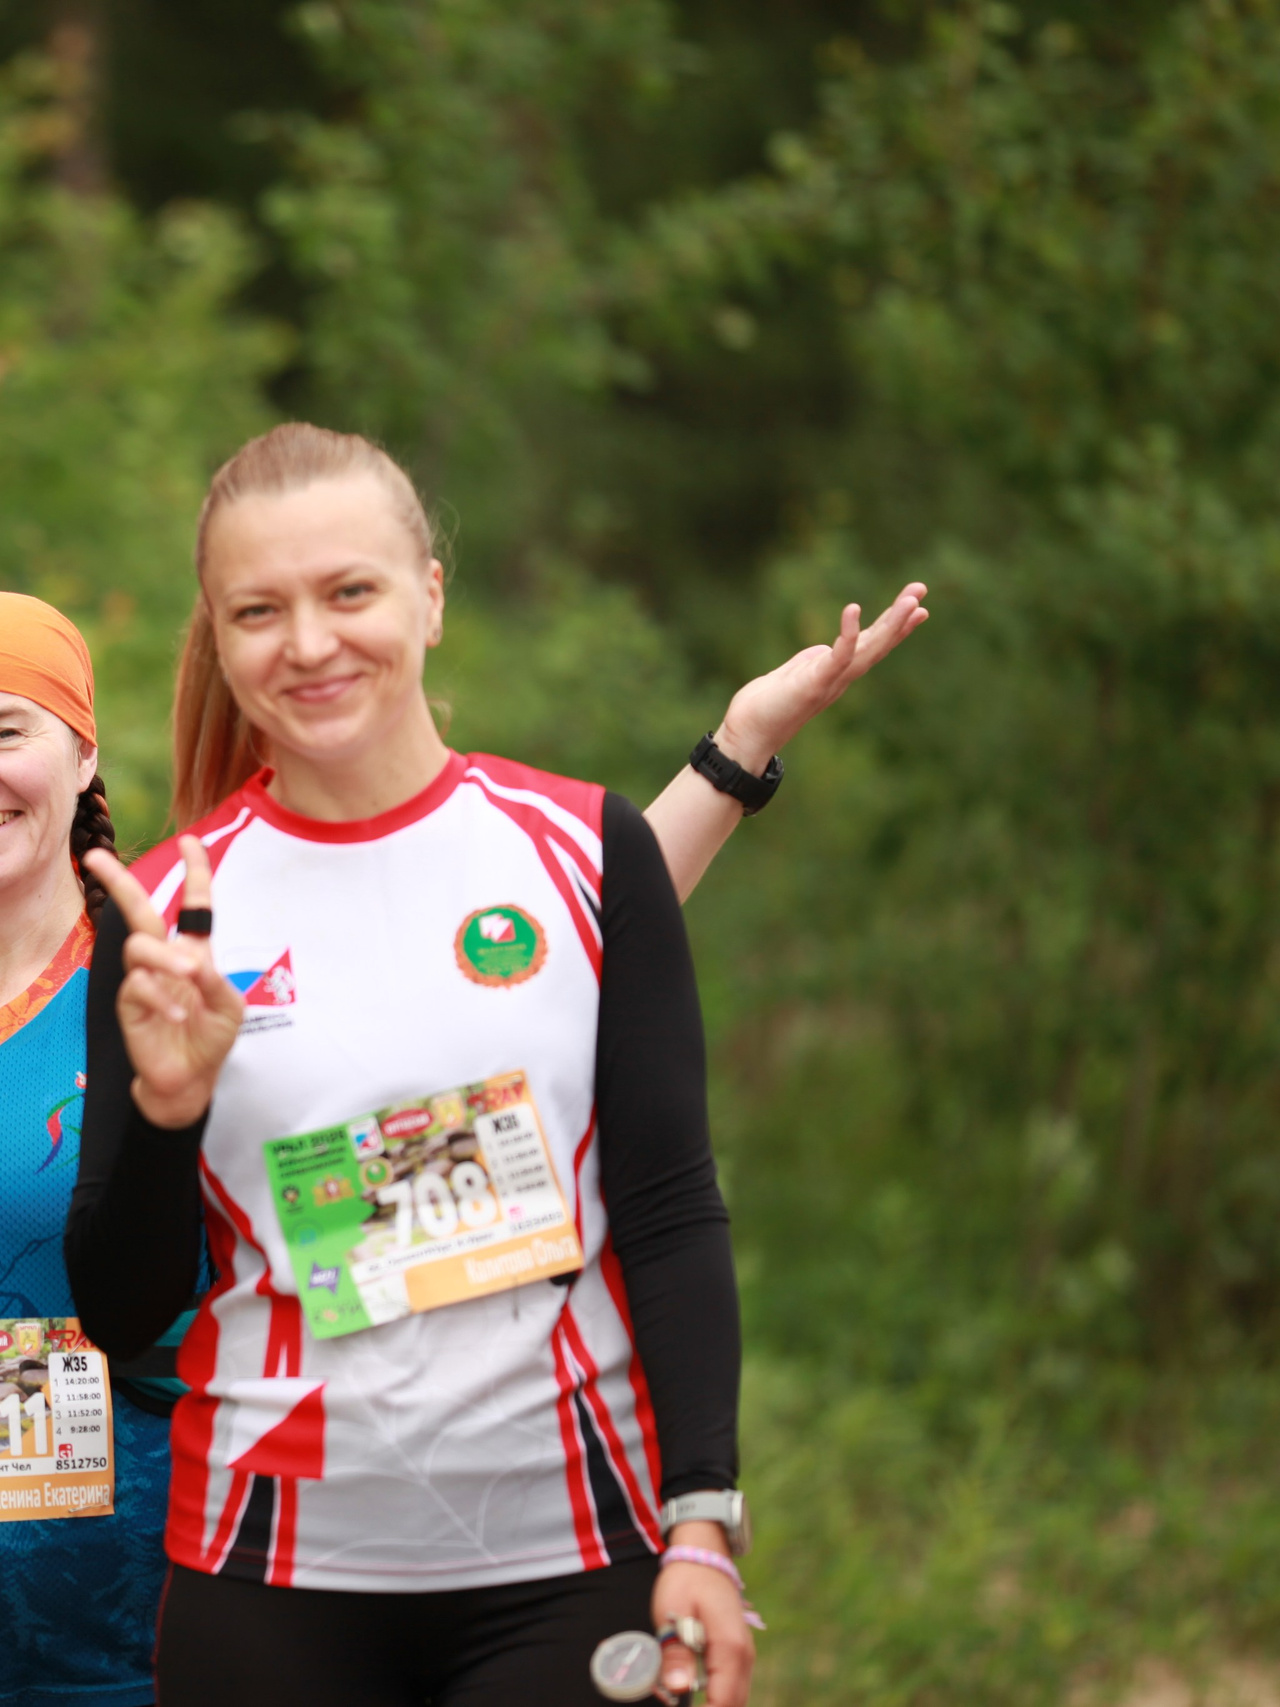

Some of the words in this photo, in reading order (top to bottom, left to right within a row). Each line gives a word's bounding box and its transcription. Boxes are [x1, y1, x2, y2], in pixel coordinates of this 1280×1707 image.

[377, 1161, 497, 1247] 708
[62, 1356, 88, 1373] Ж35
[65, 1377, 100, 1386] 14:20:00
[54, 1394, 61, 1404] 2
[66, 1393, 101, 1402] 11:58:00
[55, 1410, 62, 1420] 3
[68, 1409, 103, 1418] 11:52:00
[55, 1426, 62, 1436] 4
[70, 1425, 101, 1434] 9:28:00
[11, 1463, 32, 1473] Чел
[55, 1457, 107, 1470] 8512750
[43, 1482, 111, 1509] Екатерина
